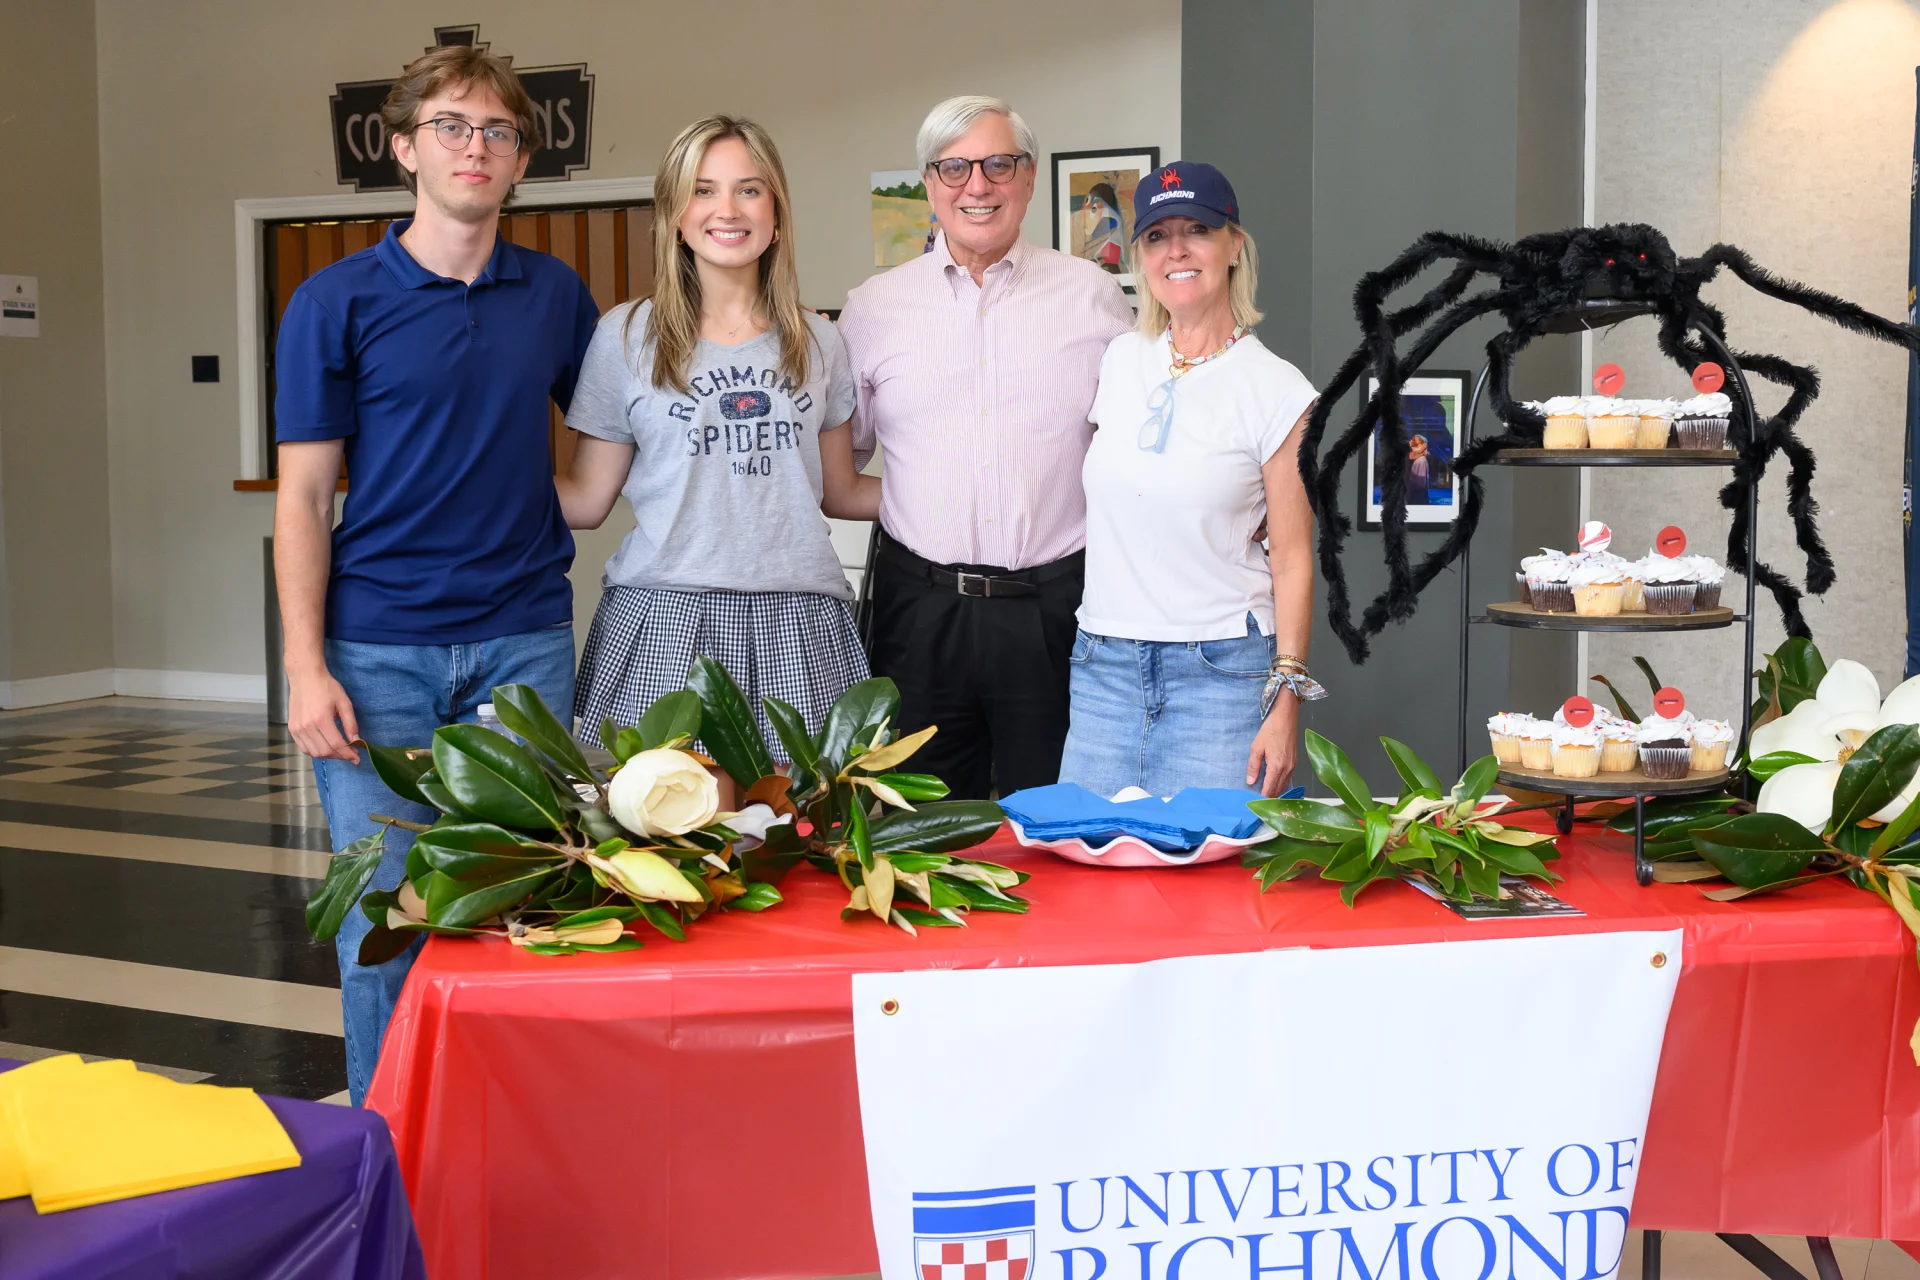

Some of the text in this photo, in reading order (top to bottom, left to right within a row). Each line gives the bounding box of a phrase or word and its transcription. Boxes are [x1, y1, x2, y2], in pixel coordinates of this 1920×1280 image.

[1149, 190, 1195, 205] RICHMOND
[732, 455, 771, 477] 1840
[1052, 1137, 1638, 1233] UNIVERSITY OF
